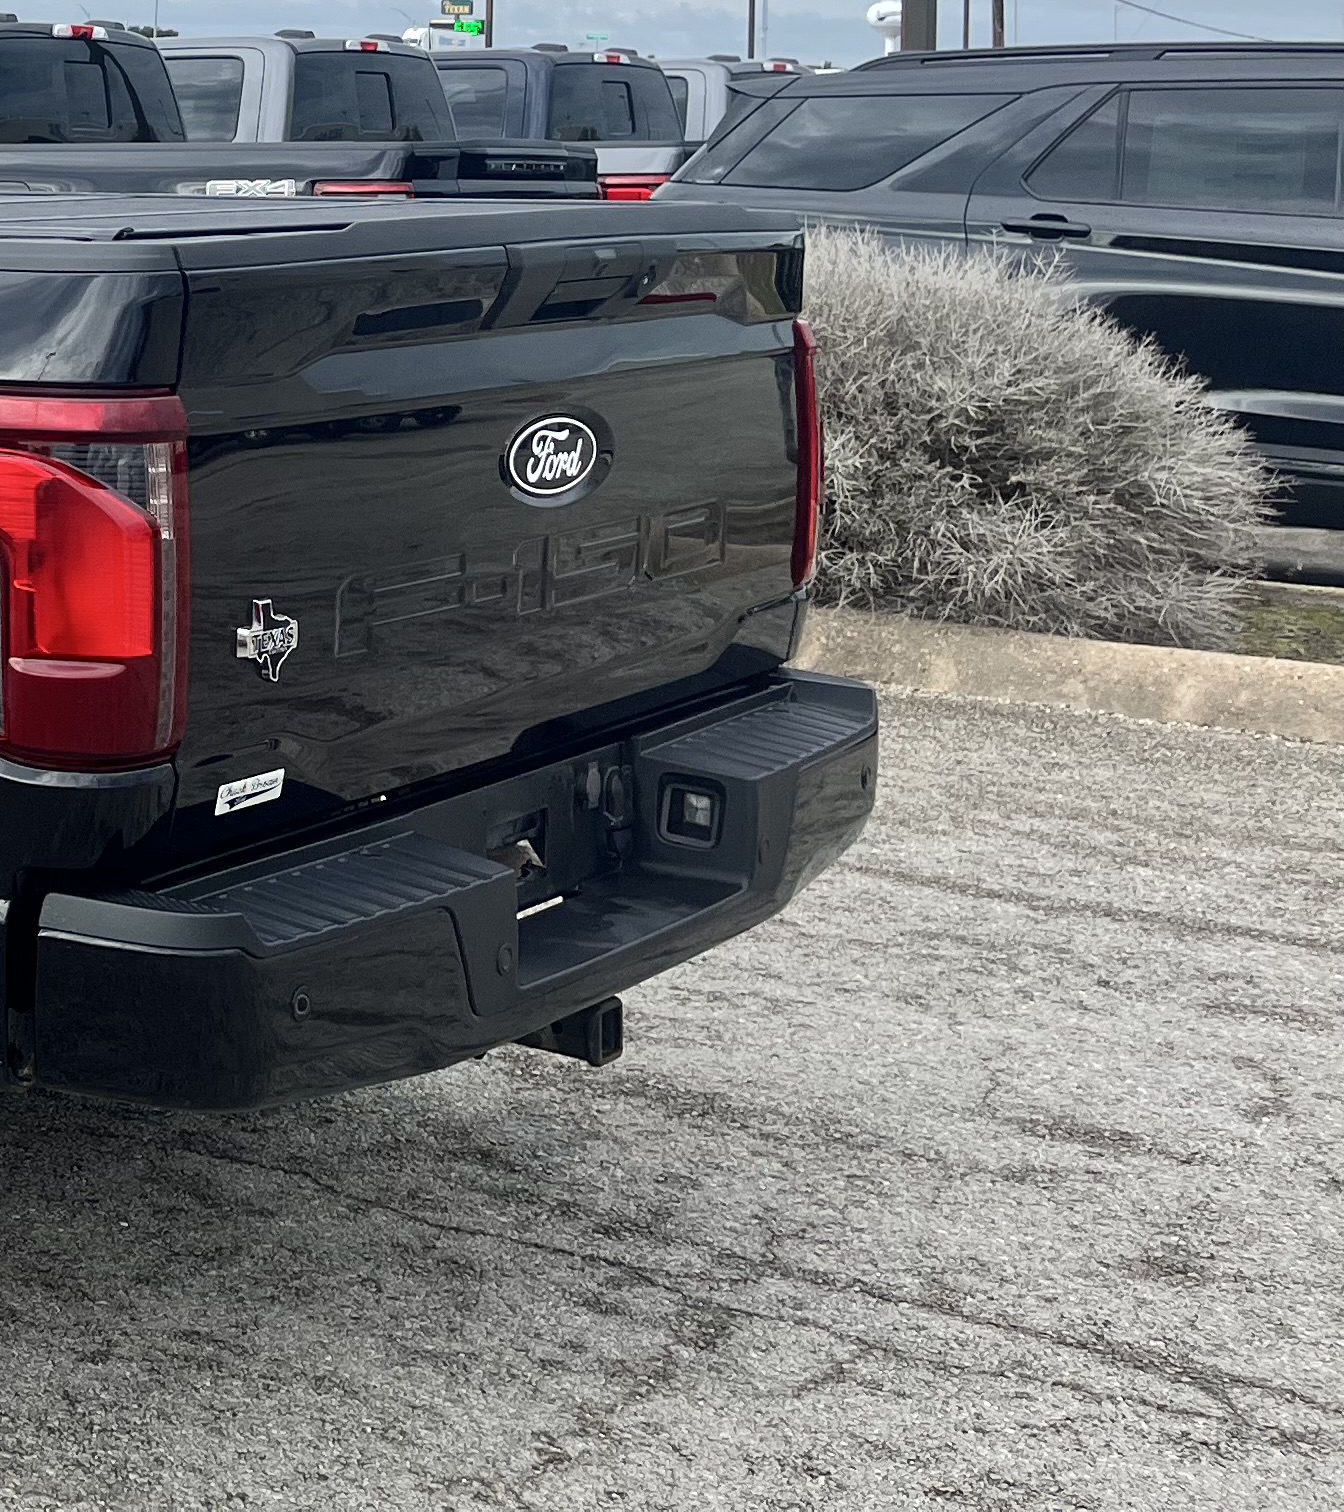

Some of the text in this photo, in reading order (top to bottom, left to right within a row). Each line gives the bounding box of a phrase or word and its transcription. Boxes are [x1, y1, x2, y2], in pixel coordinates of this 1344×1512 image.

[206, 178, 295, 196] FX4
[527, 429, 583, 483] Ford
[334, 500, 728, 659] F-150
[252, 626, 295, 652] TEXAS
